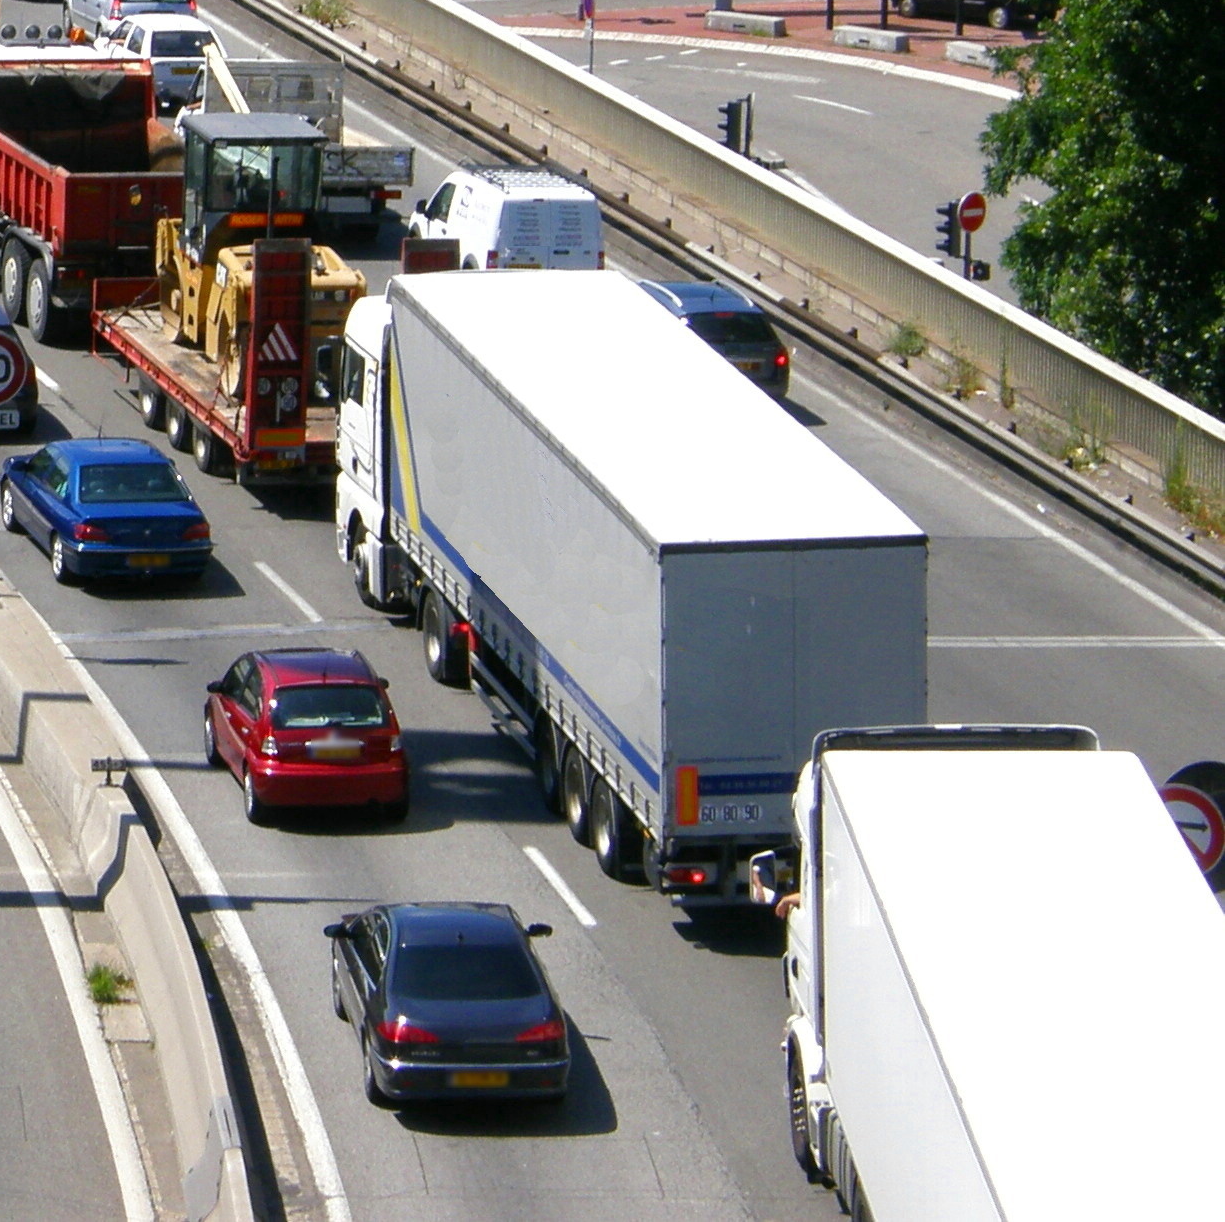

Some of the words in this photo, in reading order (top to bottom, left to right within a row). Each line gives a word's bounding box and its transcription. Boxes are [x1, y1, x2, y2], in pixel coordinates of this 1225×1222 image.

[700, 805, 716, 821] 60
[723, 805, 738, 821] 80
[744, 804, 760, 820] 90
